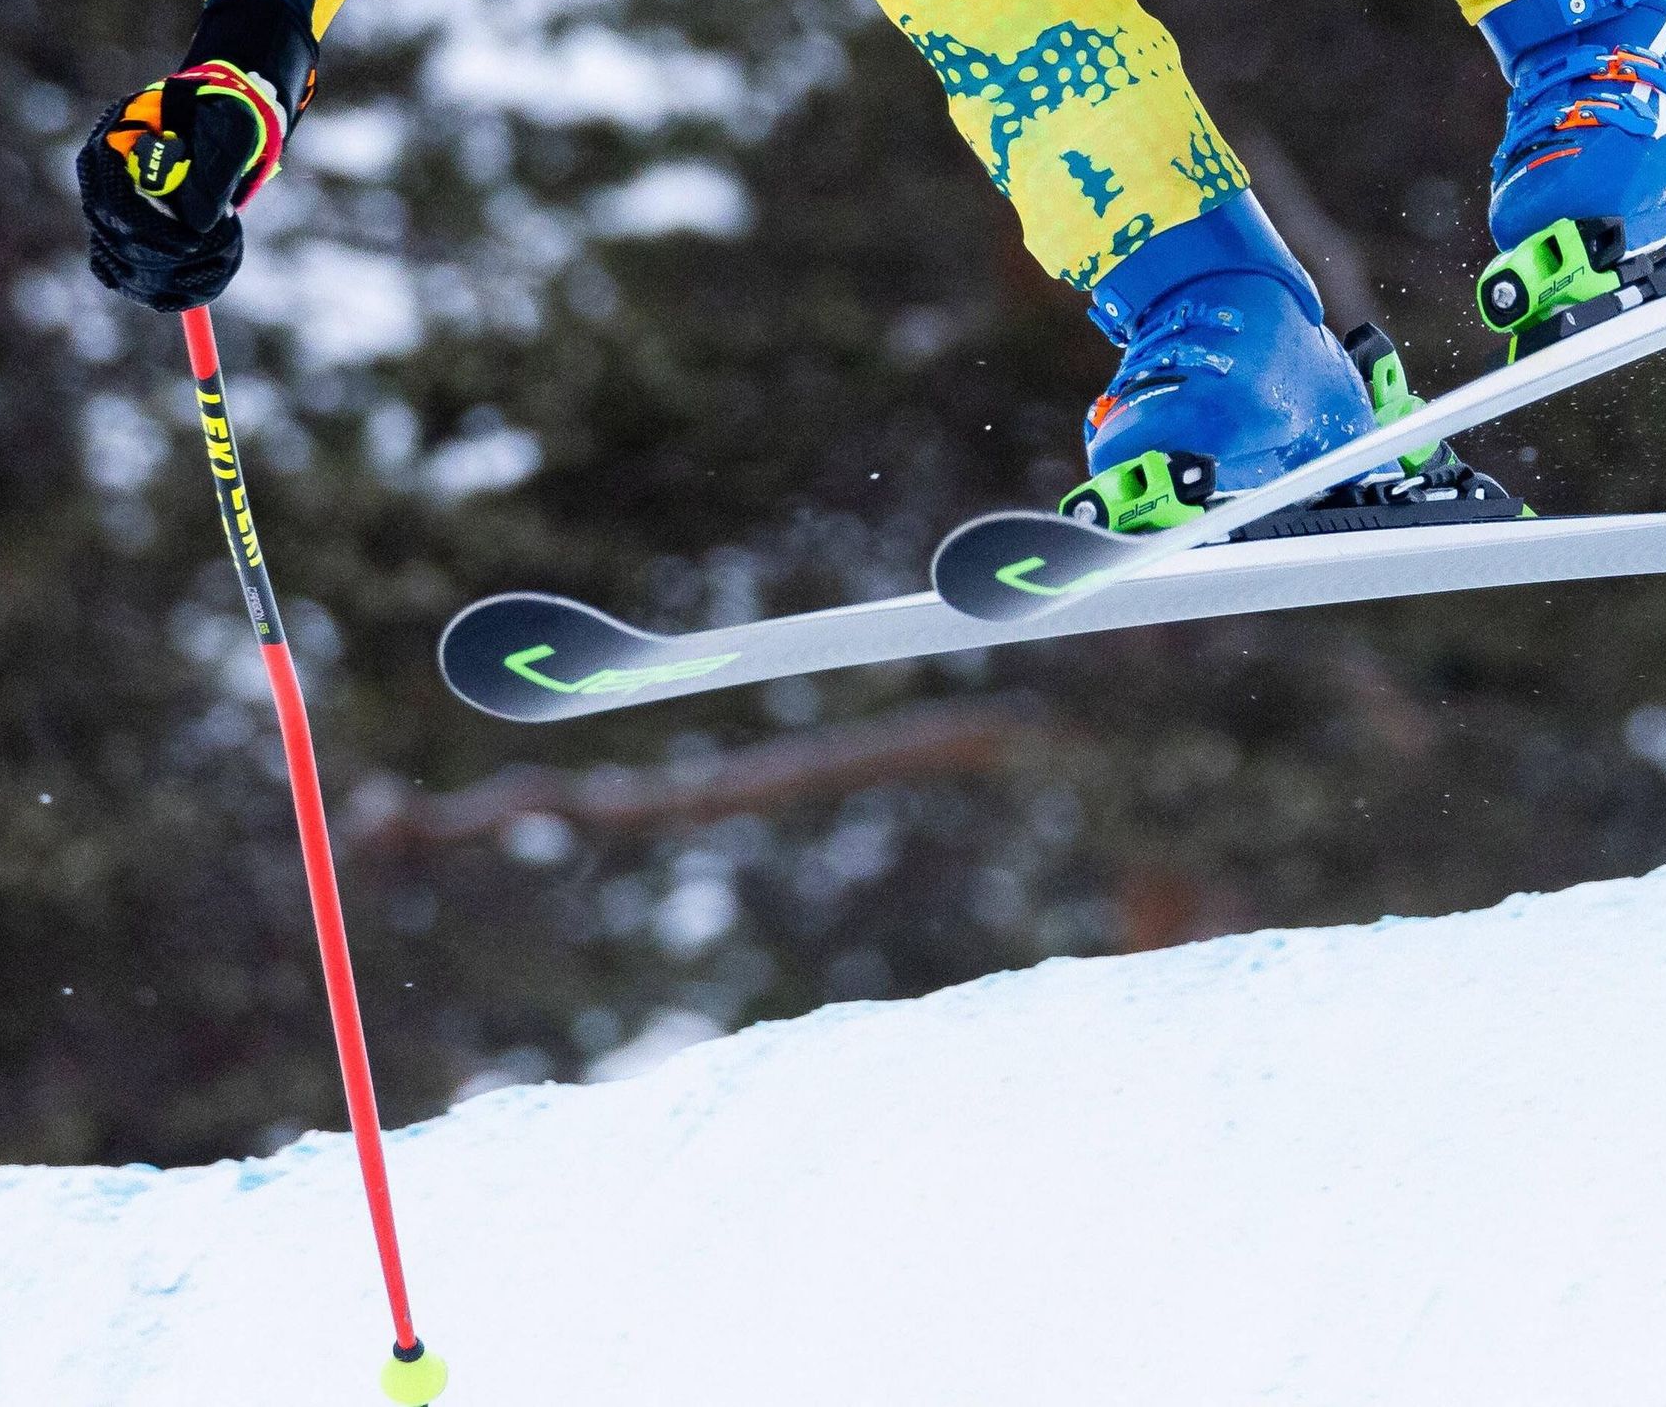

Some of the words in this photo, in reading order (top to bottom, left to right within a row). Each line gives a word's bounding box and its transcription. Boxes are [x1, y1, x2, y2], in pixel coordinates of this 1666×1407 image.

[146, 142, 166, 183] LEKI
[1537, 265, 1585, 305] elan
[1118, 493, 1170, 527] elan
